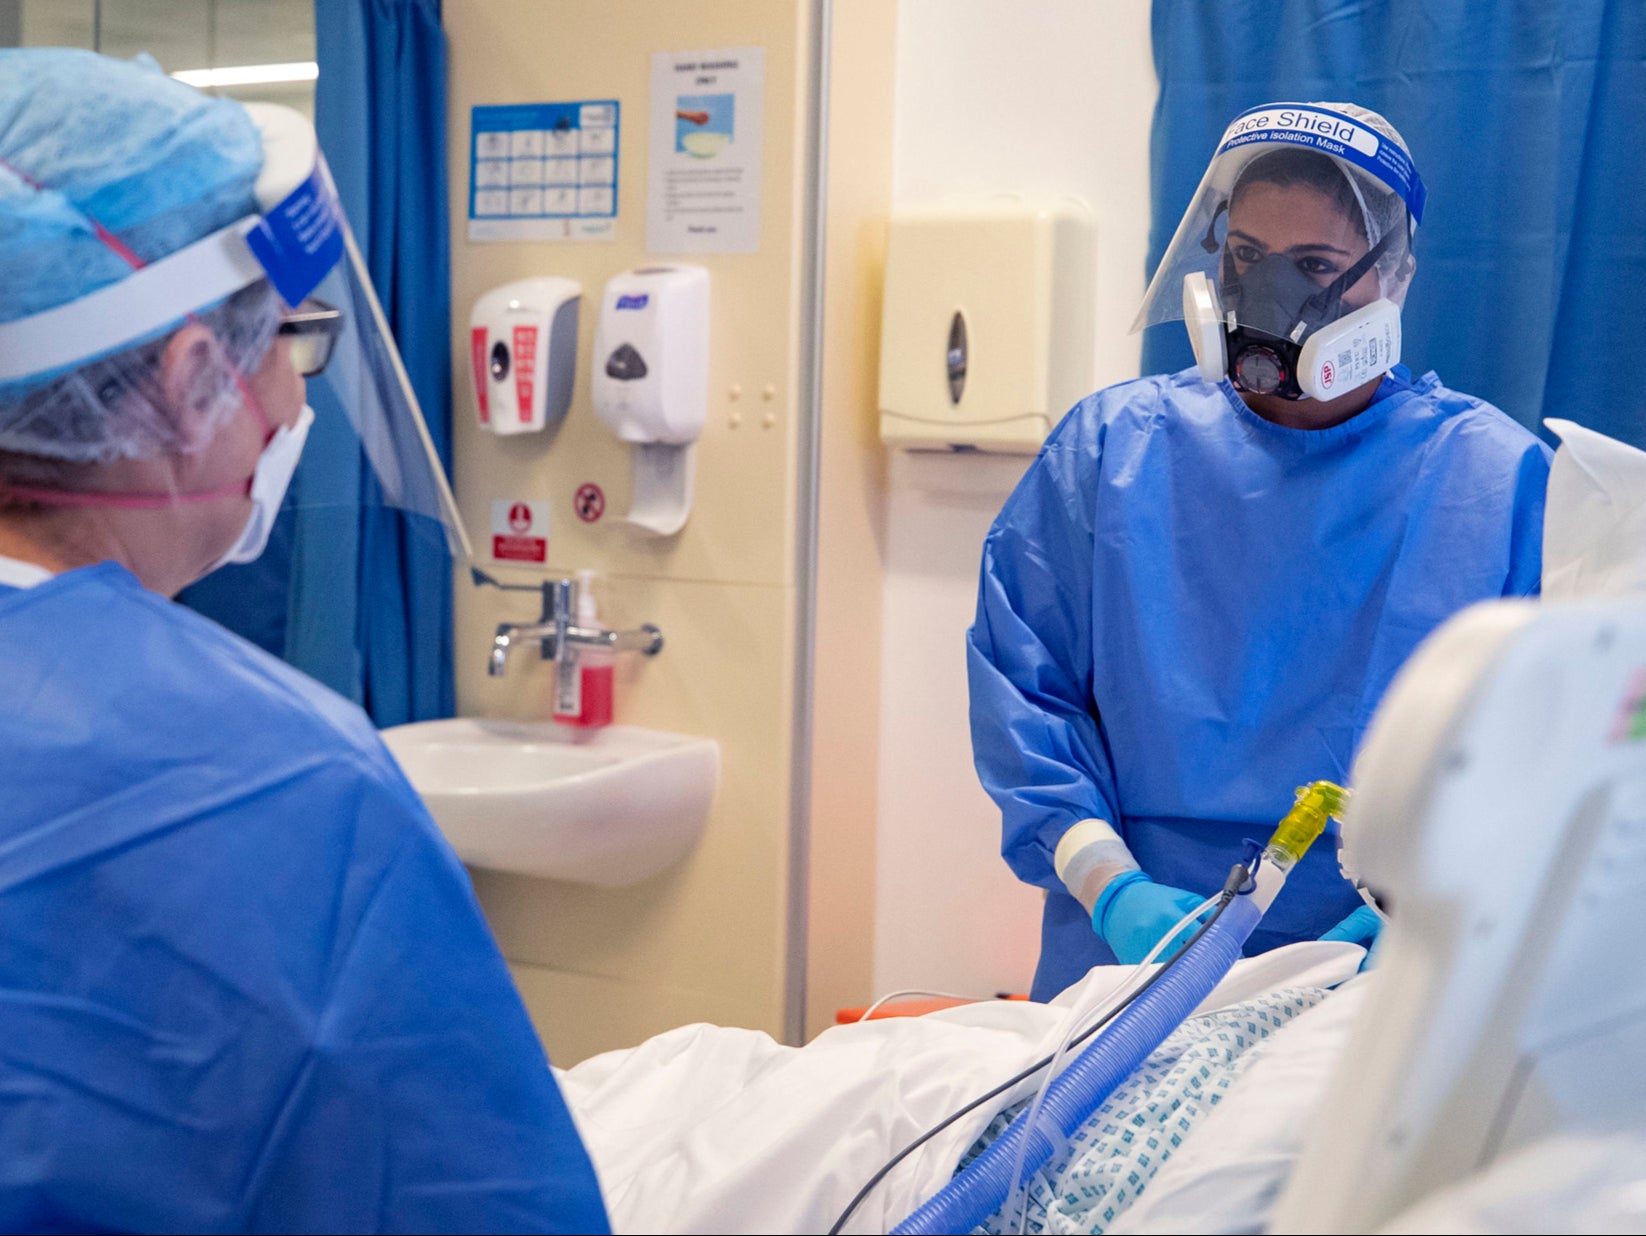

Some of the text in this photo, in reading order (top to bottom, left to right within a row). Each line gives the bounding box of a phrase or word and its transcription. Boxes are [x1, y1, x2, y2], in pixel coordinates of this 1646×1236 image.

[1277, 111, 1355, 142] Shield
[1226, 131, 1268, 149] Protective
[1316, 137, 1346, 155] Mask
